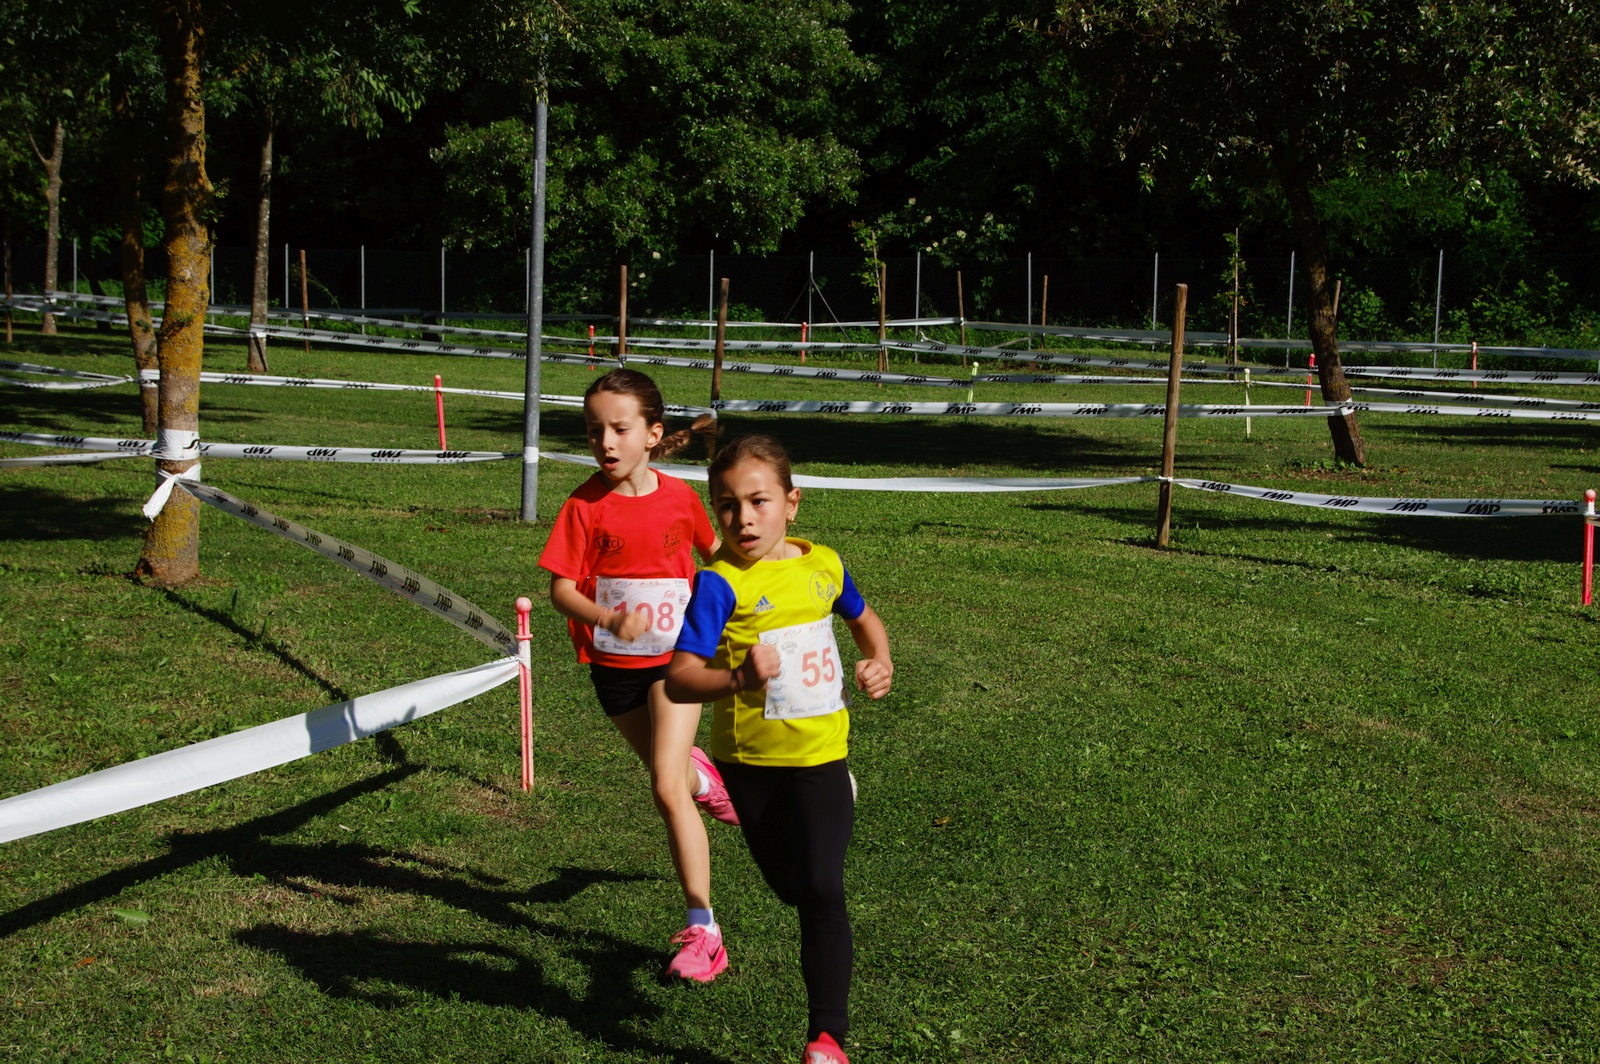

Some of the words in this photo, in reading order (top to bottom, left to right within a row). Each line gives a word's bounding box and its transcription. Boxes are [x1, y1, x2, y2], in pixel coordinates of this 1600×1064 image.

[815, 405, 849, 413] SMP
[878, 406, 913, 414] SMP
[1006, 407, 1042, 415] SMP
[117, 440, 151, 448] SMP
[242, 446, 279, 454] SMP
[306, 448, 342, 456] SMP
[370, 450, 407, 458] SMP
[436, 451, 471, 459] SMP
[1259, 491, 1294, 501] SMP
[1319, 498, 1359, 507] SMP
[1386, 502, 1428, 512] SMP
[1458, 504, 1501, 515] SMP
[1541, 505, 1580, 514] SMP
[305, 531, 322, 547] SMP
[337, 545, 355, 562] SMP
[368, 561, 388, 578] SMP
[401, 577, 421, 595] SMP
[433, 593, 453, 612] SMP
[464, 611, 484, 630] SMP
[613, 601, 675, 633] 108
[802, 646, 836, 688] 55
